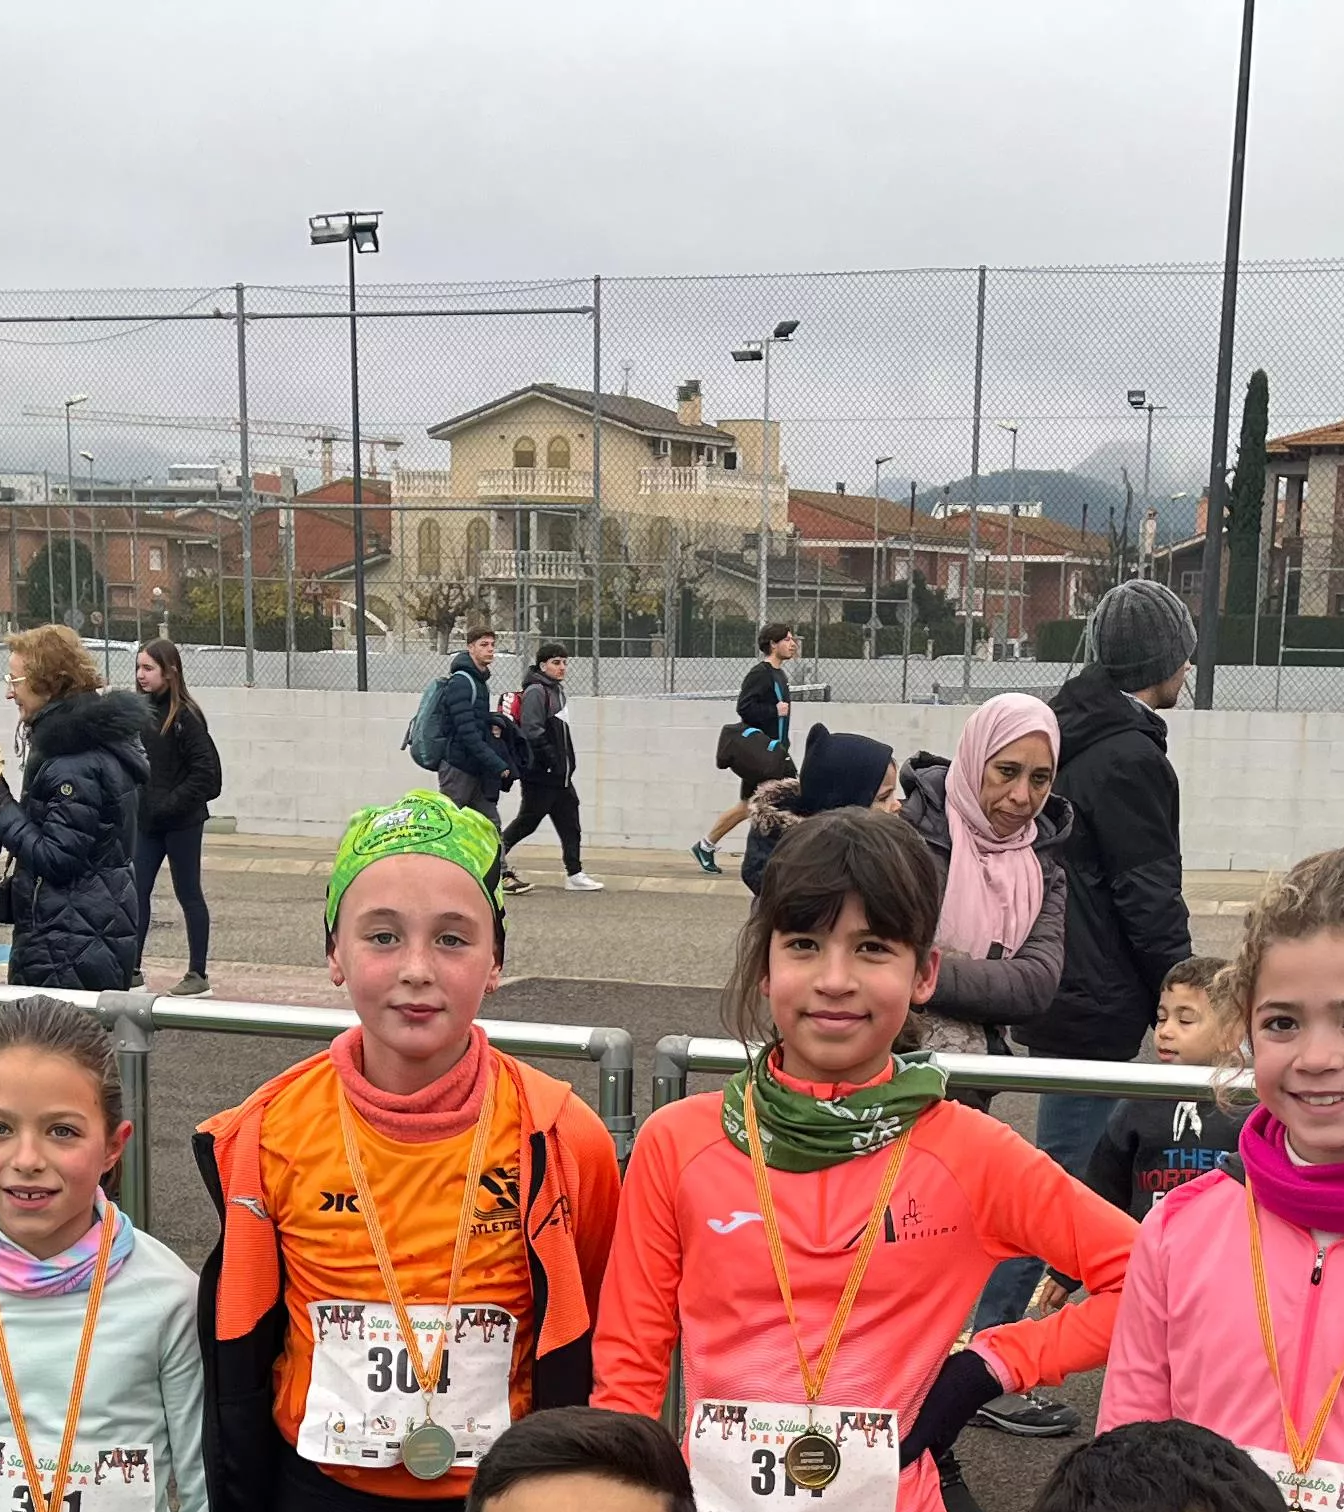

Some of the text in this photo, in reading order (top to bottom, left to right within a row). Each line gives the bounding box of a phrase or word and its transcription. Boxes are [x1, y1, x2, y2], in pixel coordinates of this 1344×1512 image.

[469, 1220, 521, 1237] ATLETIS
[749, 1418, 833, 1434] San Silvetre
[751, 1448, 827, 1498] 31
